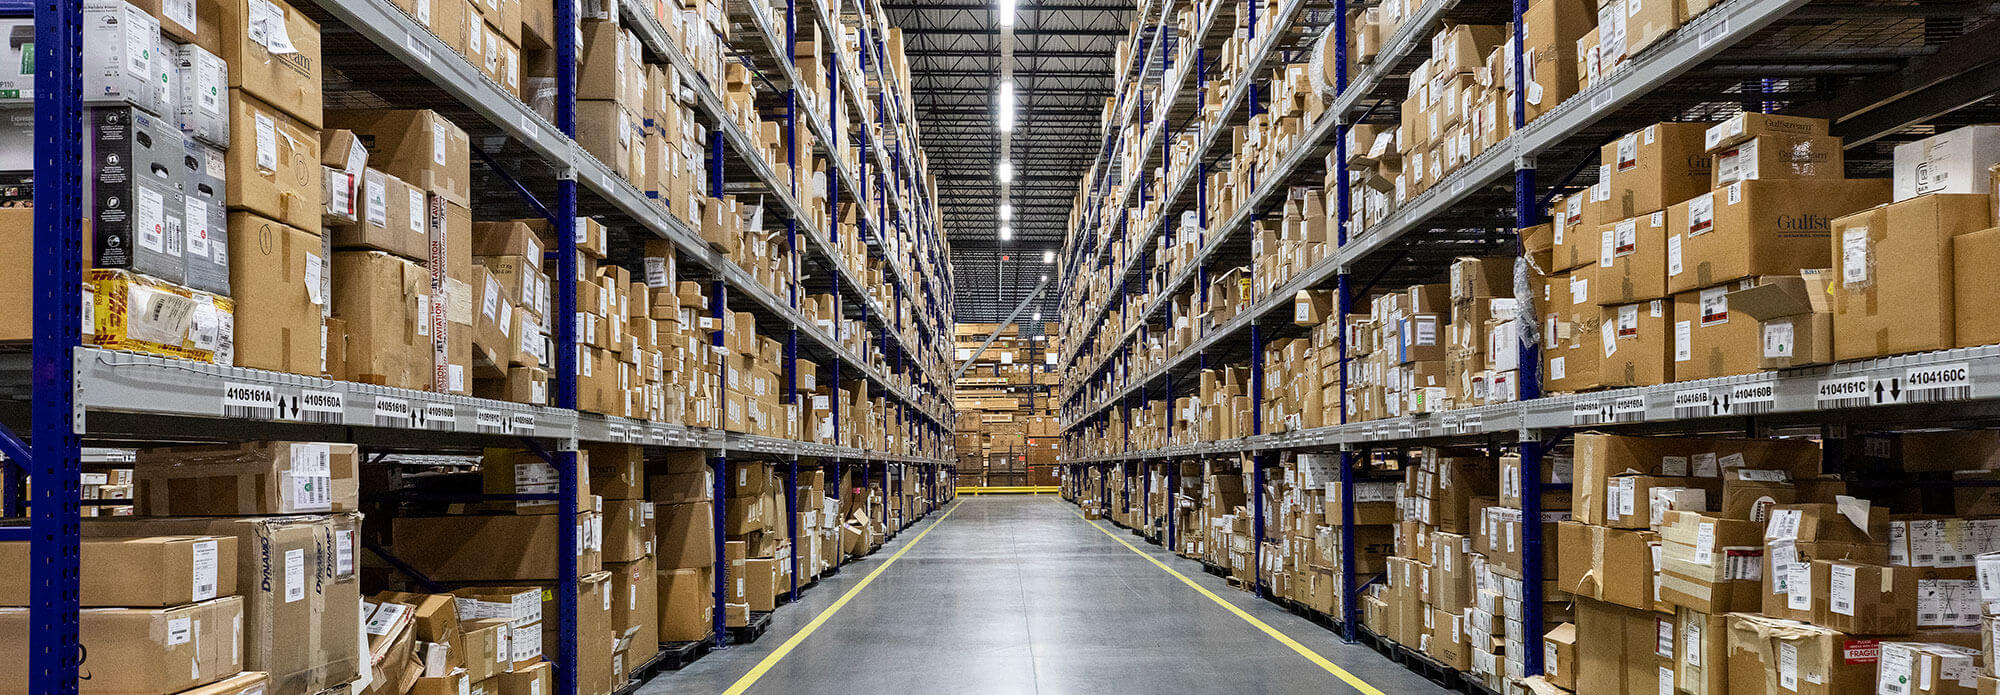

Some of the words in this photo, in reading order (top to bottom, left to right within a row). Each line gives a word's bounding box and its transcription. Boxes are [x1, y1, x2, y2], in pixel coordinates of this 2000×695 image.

[1909, 368, 1966, 385] 4104160C
[227, 387, 272, 403] 4105161A
[1734, 386, 1772, 400] 4104160B
[1820, 381, 1866, 396] 4104161C
[304, 394, 341, 408] 4105160A
[1676, 392, 1708, 405] 4104161B
[377, 400, 407, 414] 4105161B
[261, 536, 271, 593] DYNAMO
